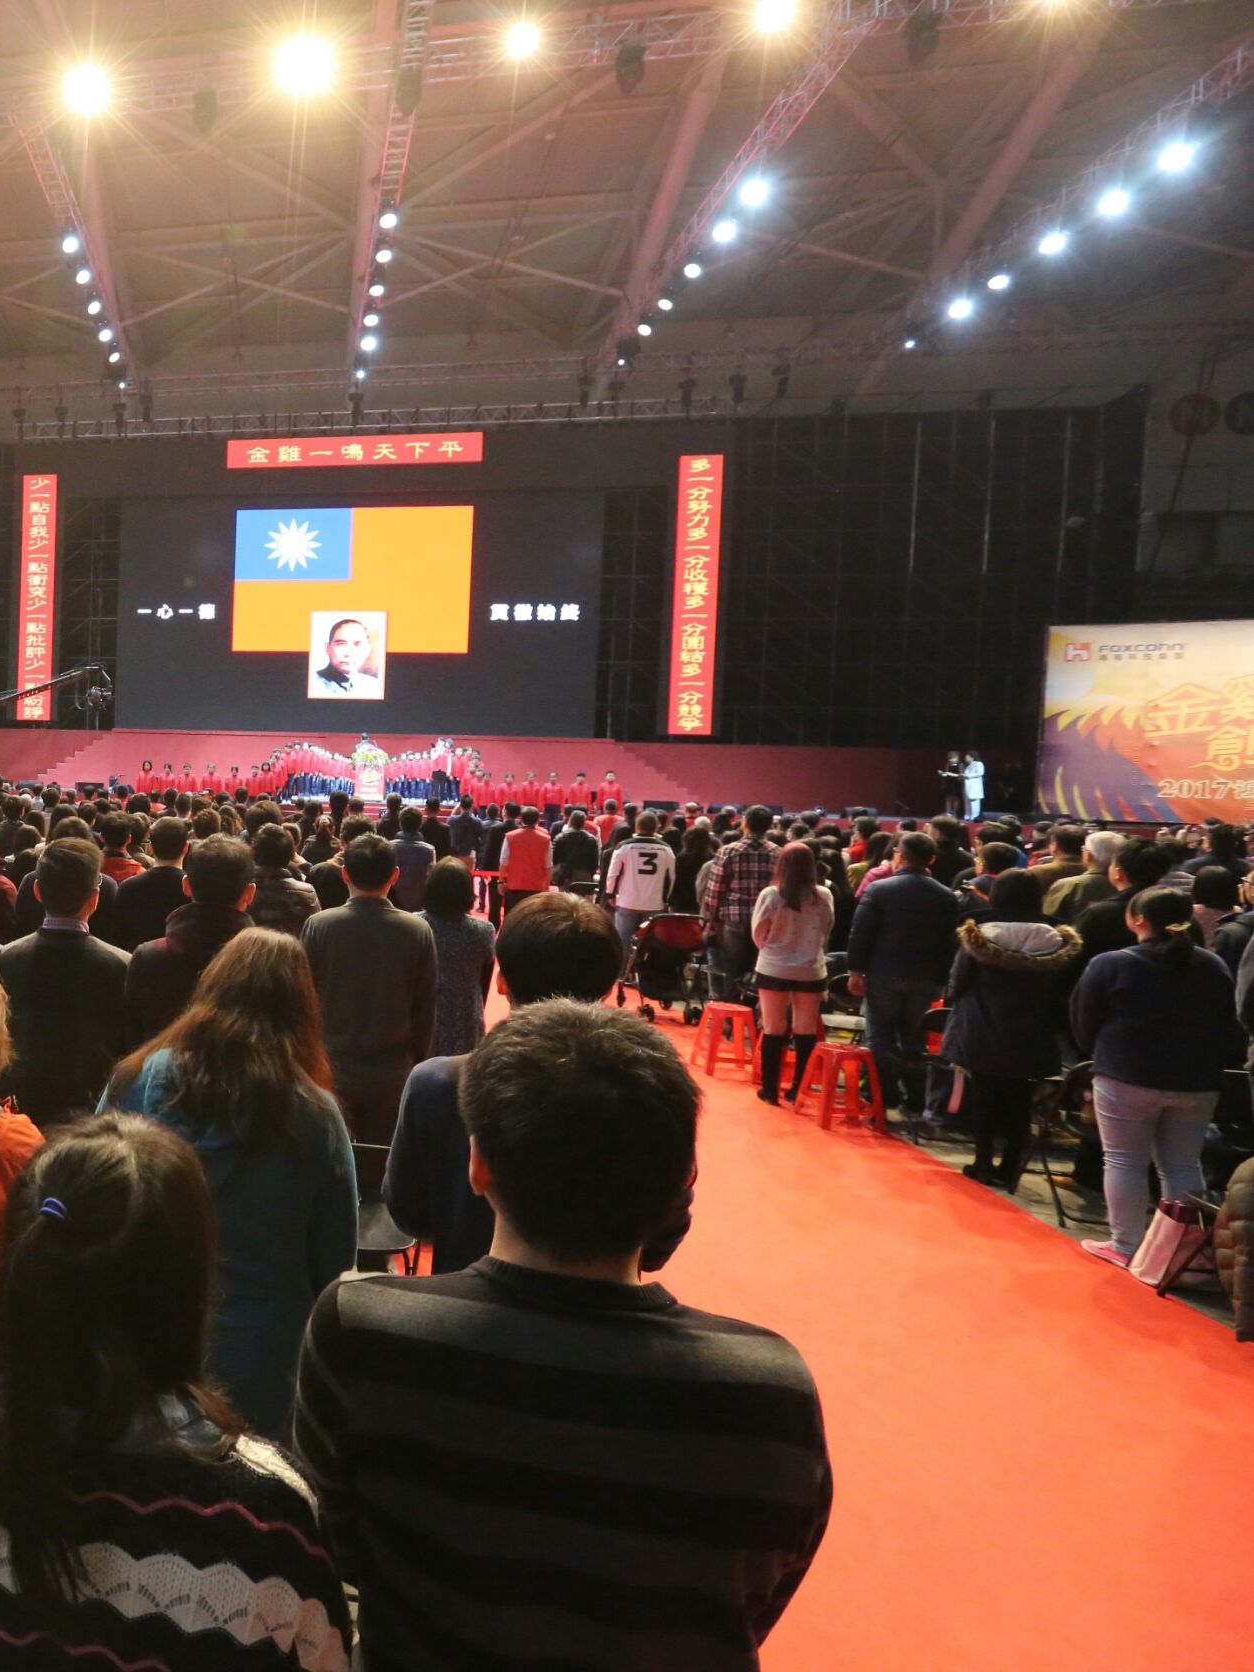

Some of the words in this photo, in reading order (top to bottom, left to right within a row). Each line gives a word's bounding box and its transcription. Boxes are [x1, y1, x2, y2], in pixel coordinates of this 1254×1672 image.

[246, 440, 464, 463] 金雞一鳴天下平
[637, 852, 659, 875] 3
